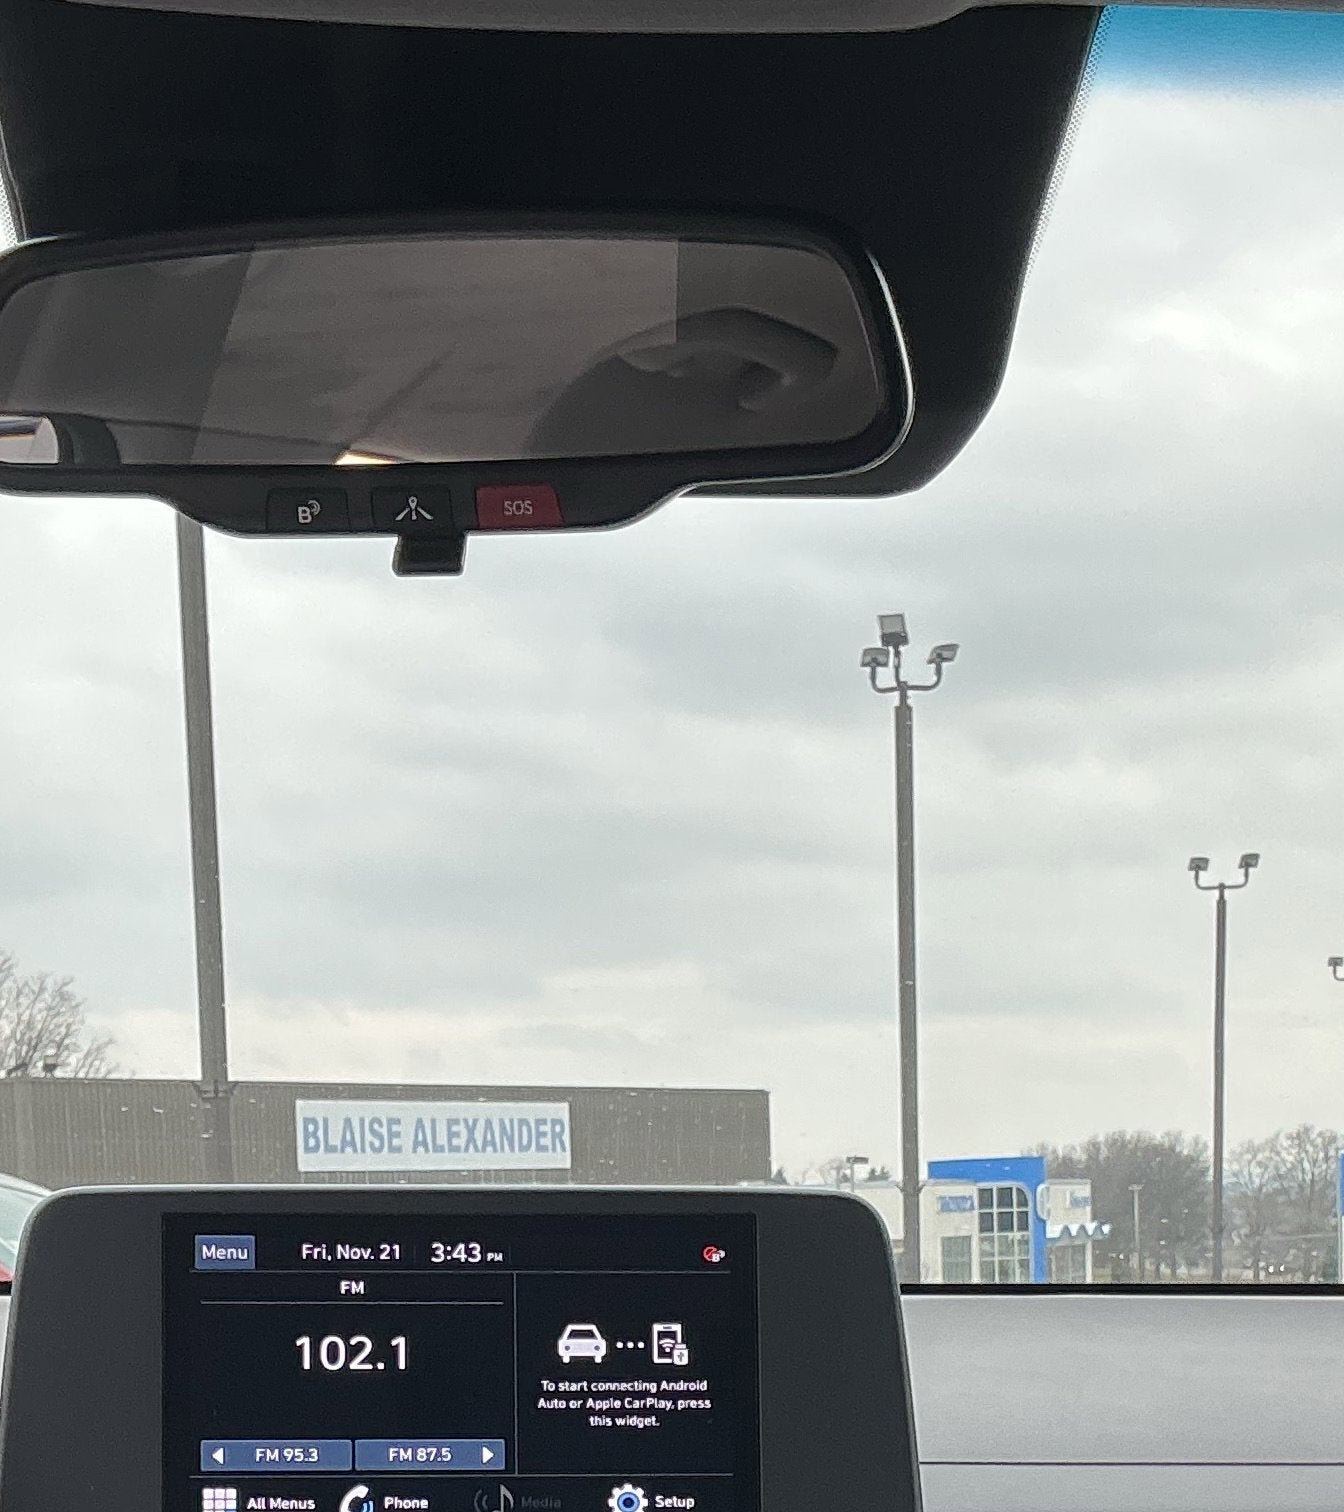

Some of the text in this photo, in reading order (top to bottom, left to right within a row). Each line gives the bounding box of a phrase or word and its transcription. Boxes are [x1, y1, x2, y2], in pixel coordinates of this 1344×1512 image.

[503, 500, 533, 516] SOS
[302, 1116, 568, 1154] BLAISE ALEXANDER
[202, 1245, 248, 1260] Menu
[302, 1244, 401, 1261] Fri, Nov. 21
[430, 1243, 503, 1263] 3:43 PM
[339, 1281, 365, 1295] FM
[295, 1336, 407, 1370] 102.1
[541, 1380, 707, 1393] To start connecting Android
[538, 1398, 566, 1409] Auto
[569, 1401, 583, 1409] or
[586, 1398, 621, 1411] Apple
[678, 1401, 712, 1411] press
[589, 1416, 660, 1428] this widget.
[256, 1449, 319, 1462] FM 95.3
[389, 1448, 452, 1461] FM 87.5
[247, 1498, 316, 1510] All Menus
[384, 1497, 429, 1509] Phone
[521, 1497, 562, 1508] Media
[655, 1496, 695, 1510] Setup
